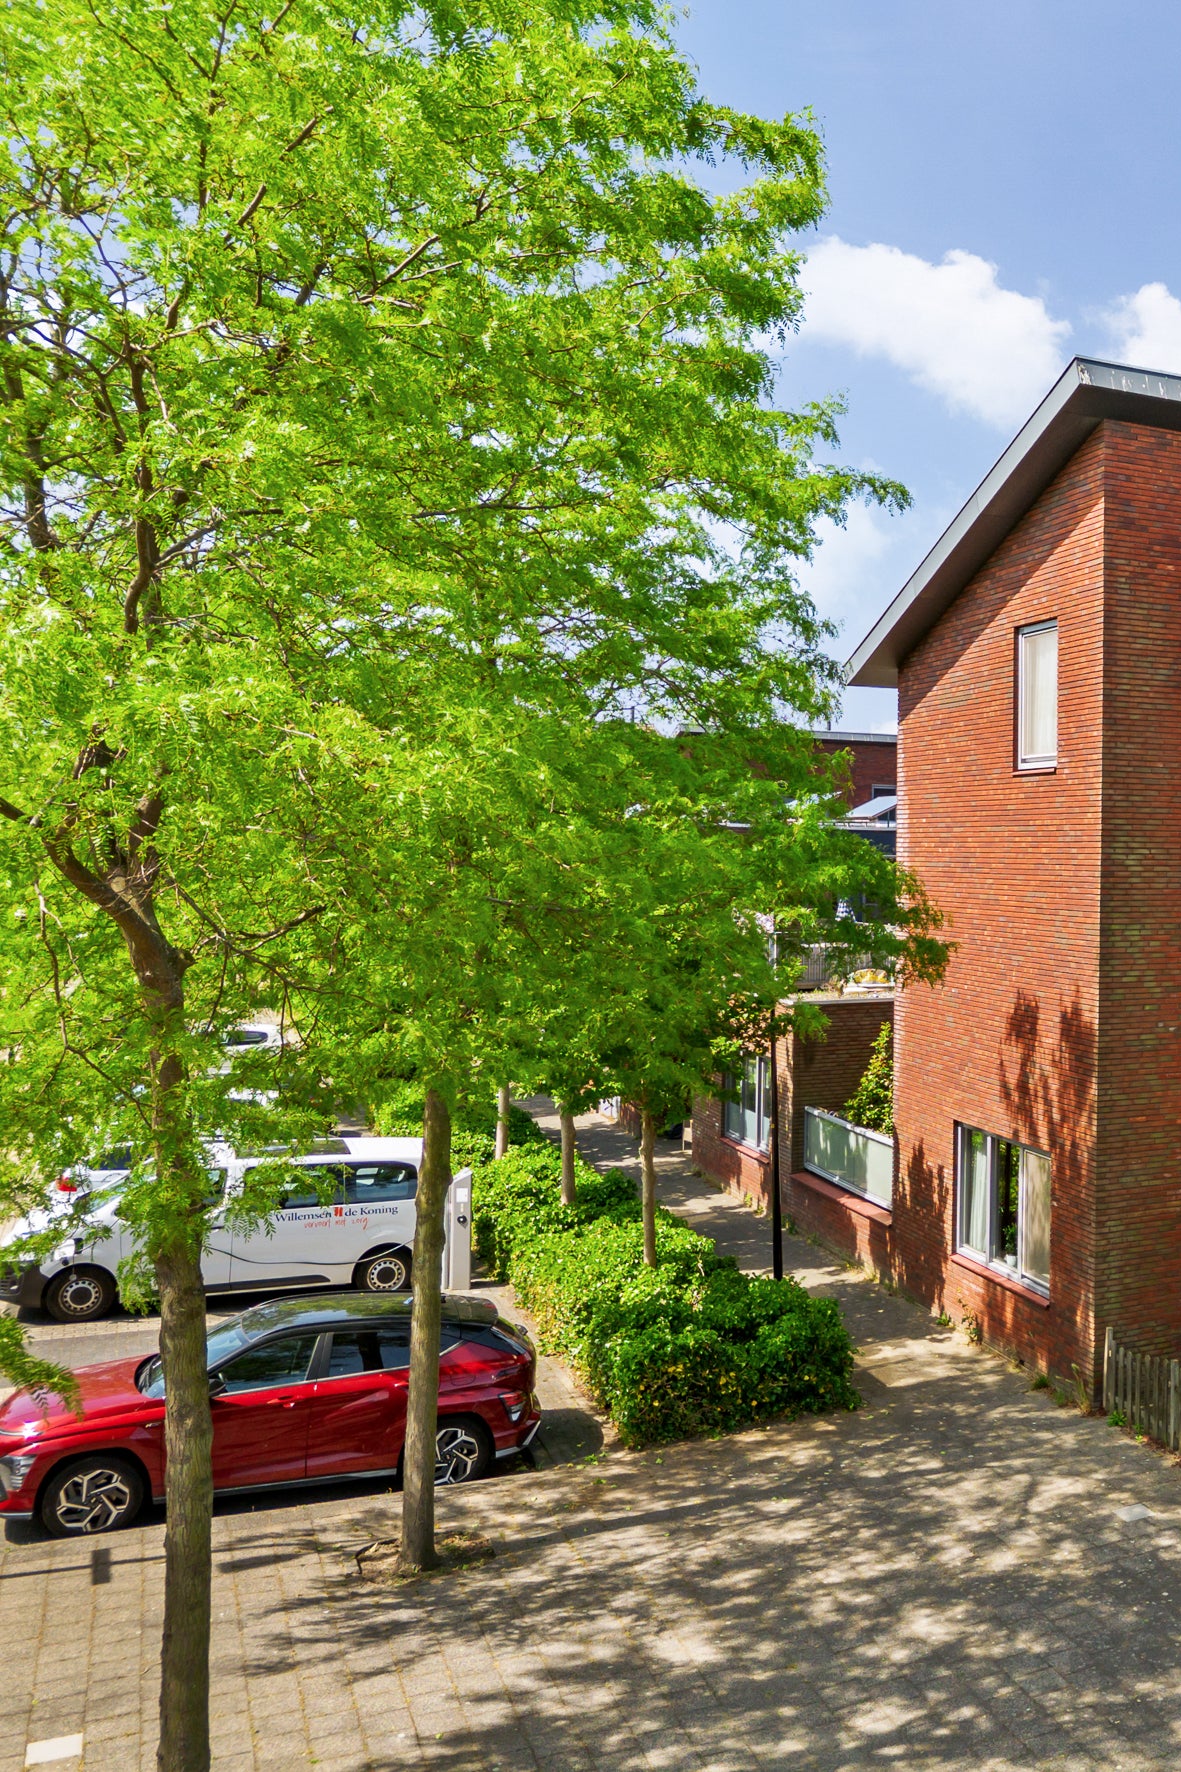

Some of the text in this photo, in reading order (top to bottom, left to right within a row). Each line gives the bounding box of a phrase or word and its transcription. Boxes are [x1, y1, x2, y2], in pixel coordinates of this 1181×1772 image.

[275, 1205, 399, 1222] Willemsen de Koning
